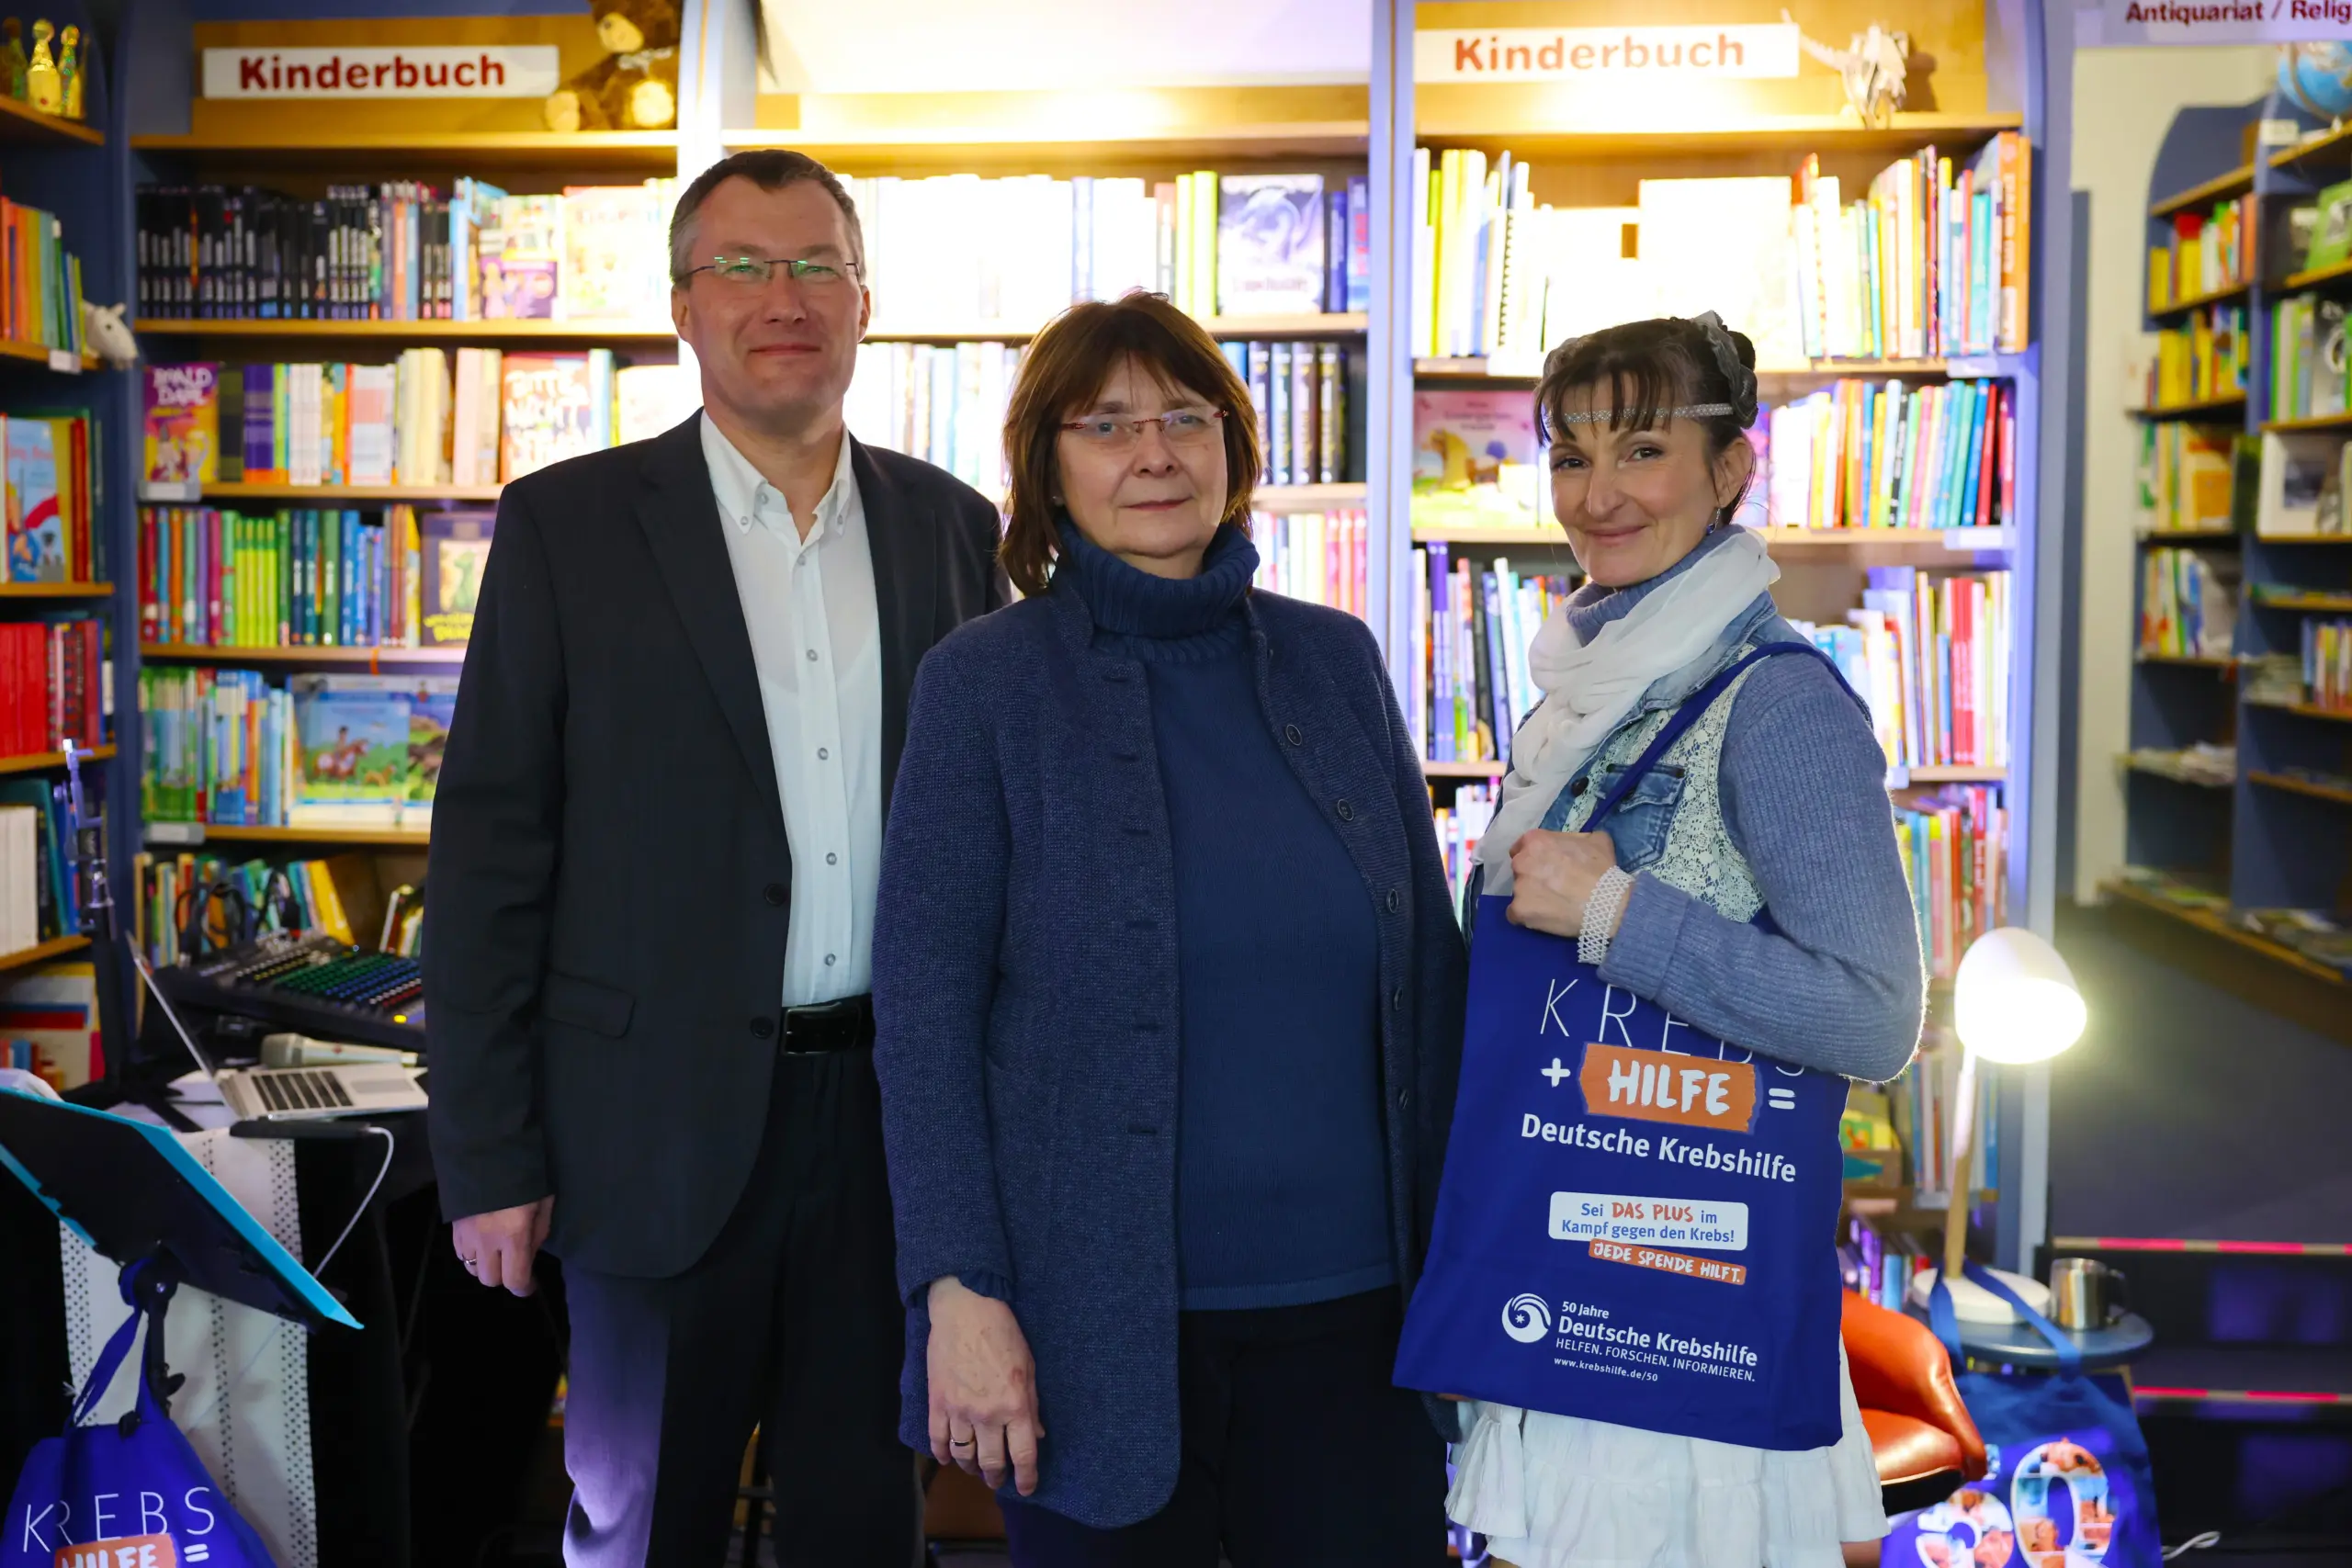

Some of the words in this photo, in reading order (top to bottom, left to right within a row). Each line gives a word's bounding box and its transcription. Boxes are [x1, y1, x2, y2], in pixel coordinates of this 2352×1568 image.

[2126, 0, 2264, 25] Antiquariat
[1454, 32, 1745, 71] Kinderbuch
[240, 53, 505, 90] Kinderbuch
[1540, 978, 1805, 1077] KRE
[1607, 1059, 1731, 1115] HILFE
[1521, 1113, 1650, 1157] Deutsche
[1658, 1136, 1797, 1182] Krebshilfe
[1562, 1220, 1609, 1236] Kampf
[1611, 1225, 1656, 1240] gegen
[1659, 1226, 1686, 1239] den
[1690, 1227, 1735, 1244] Krebs!
[1581, 1202, 1604, 1217] Sei
[1611, 1201, 1645, 1220] DAS
[1653, 1204, 1694, 1223] PLUS
[1701, 1210, 1717, 1224] im
[1593, 1243, 1633, 1262] JEDE
[1638, 1250, 1694, 1273] SPENDE
[1700, 1261, 1741, 1283] HILFT.
[1562, 1302, 1577, 1314] 50
[1578, 1303, 1610, 1320] Jahre
[1555, 1337, 1603, 1356] HELFEN.
[1605, 1346, 1670, 1369] FORSCHEN.
[1672, 1358, 1756, 1383] INFORMIEREN.
[1558, 1315, 1651, 1349] Deutsche
[1657, 1333, 1758, 1367] Krebshilfe
[1554, 1356, 1658, 1382] www.krebshilfe.de/50
